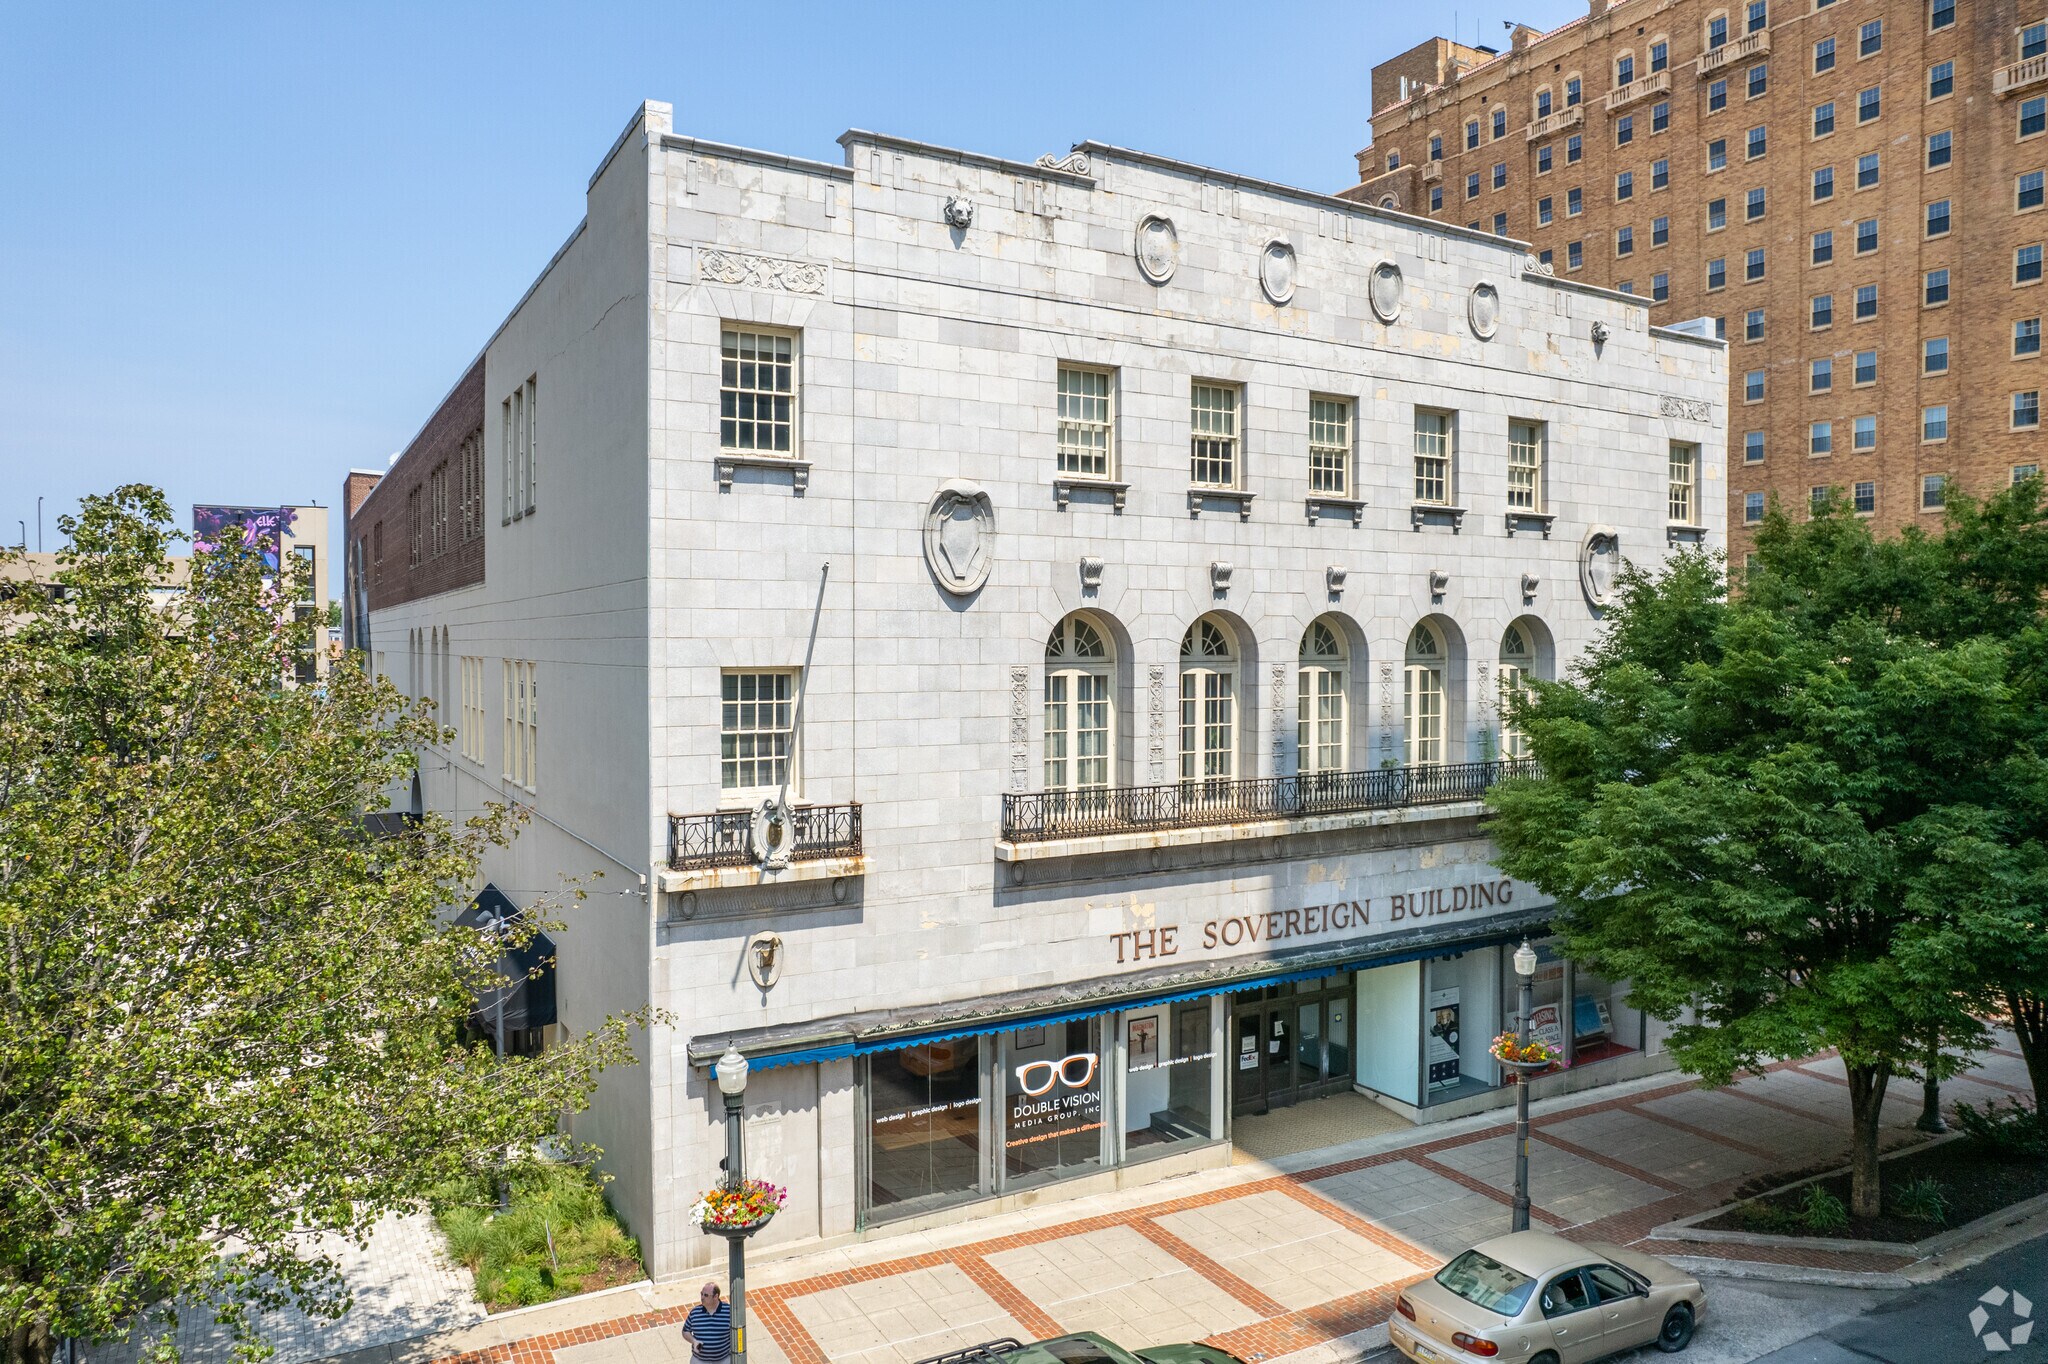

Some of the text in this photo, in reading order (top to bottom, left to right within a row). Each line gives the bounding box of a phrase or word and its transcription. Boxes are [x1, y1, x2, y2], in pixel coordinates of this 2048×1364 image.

[1110, 880, 1513, 963] THE SOVEREIGN BUILDING
[1539, 1027, 1553, 1035] CLASS
[888, 1112, 906, 1121] design
[911, 1107, 931, 1117] graphic
[965, 1097, 981, 1105] design
[1014, 1091, 1100, 1118] DOUBLE VISION
[1014, 1118, 1043, 1129] MEDIA
[1085, 1105, 1100, 1114] INC
[1006, 1138, 1029, 1148] Creative
[1029, 1133, 1048, 1144] design
[1048, 1130, 1059, 1138] that
[1059, 1126, 1077, 1136] makes
